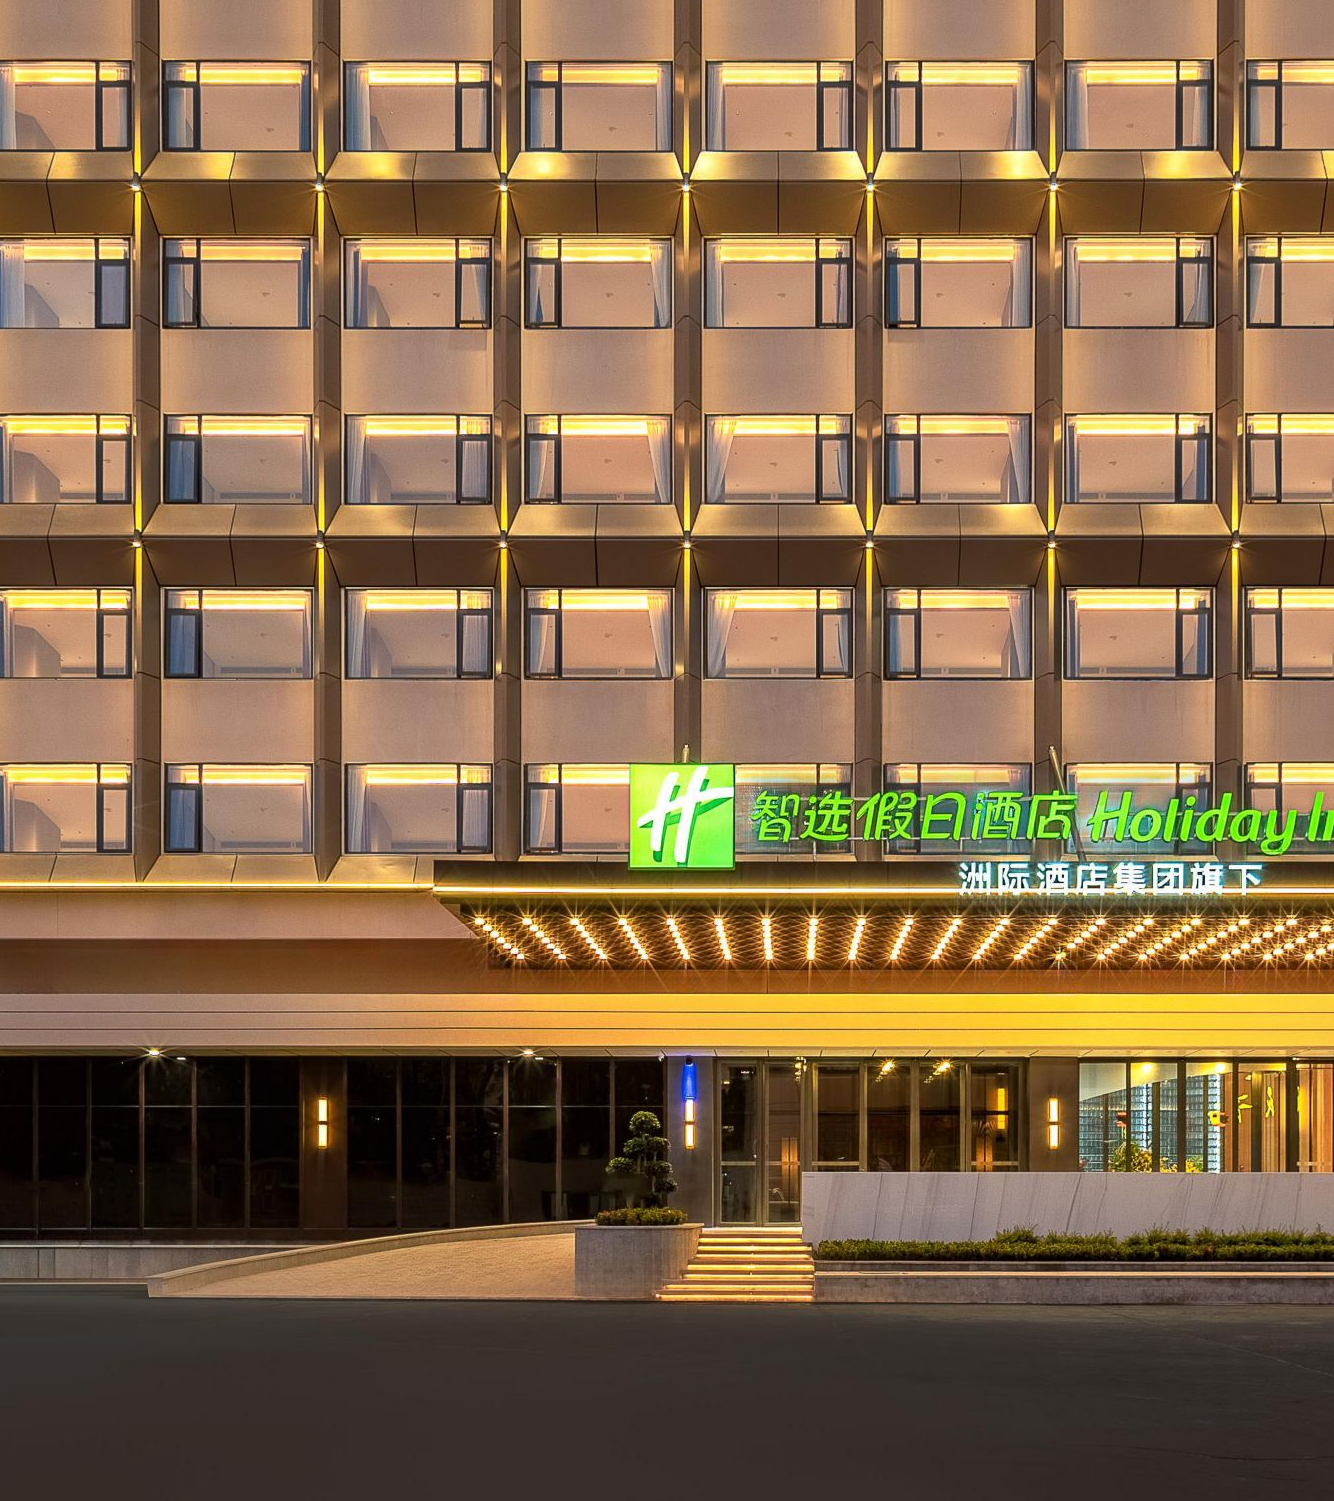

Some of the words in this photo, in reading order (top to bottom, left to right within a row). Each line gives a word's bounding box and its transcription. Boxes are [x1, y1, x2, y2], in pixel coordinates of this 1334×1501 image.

[749, 789, 1078, 843] 智选假日酒店
[1087, 790, 1297, 856] Holiday
[958, 861, 1264, 897] 洲际酒店集团旗下
